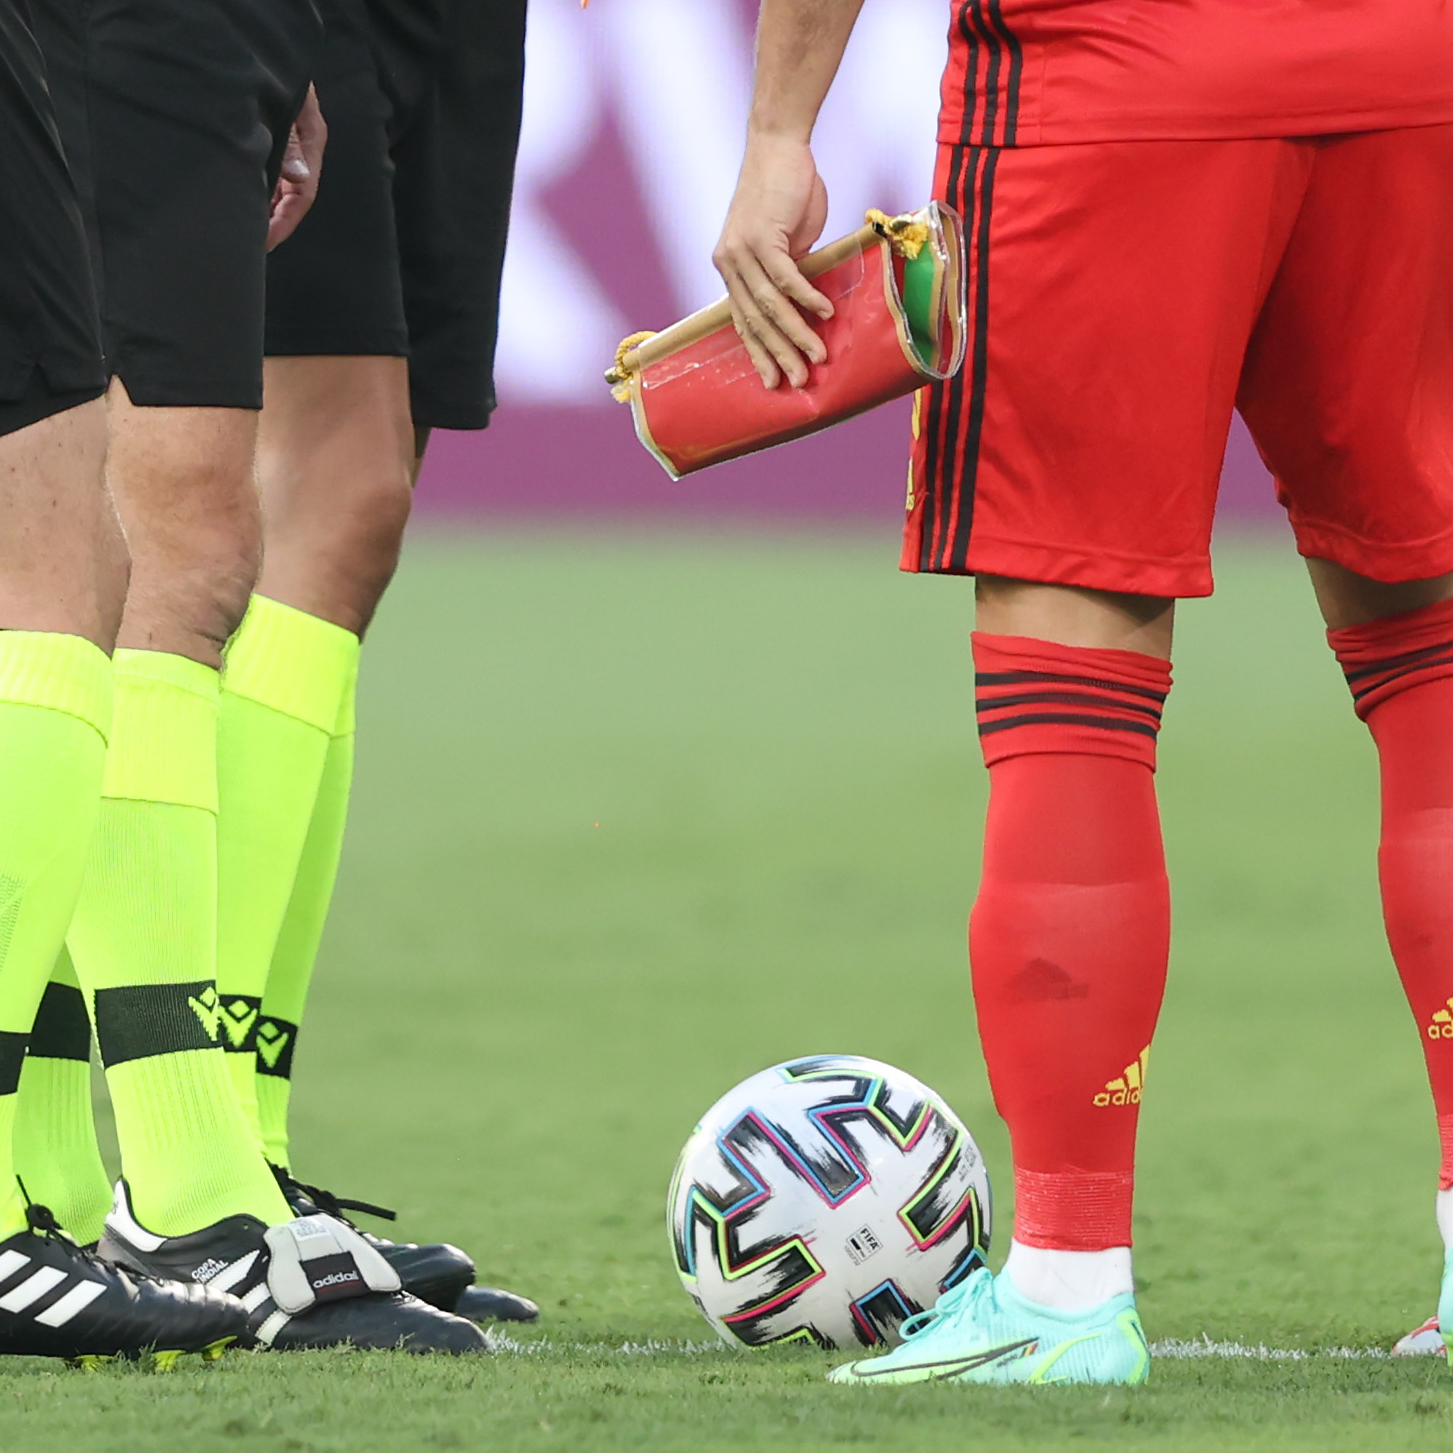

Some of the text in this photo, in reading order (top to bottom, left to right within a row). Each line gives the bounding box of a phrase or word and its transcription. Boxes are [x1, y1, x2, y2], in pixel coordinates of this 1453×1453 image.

[1093, 1087, 1144, 1107] adid
[860, 1227, 880, 1251] FIFA
[191, 1258, 218, 1279] COPA
